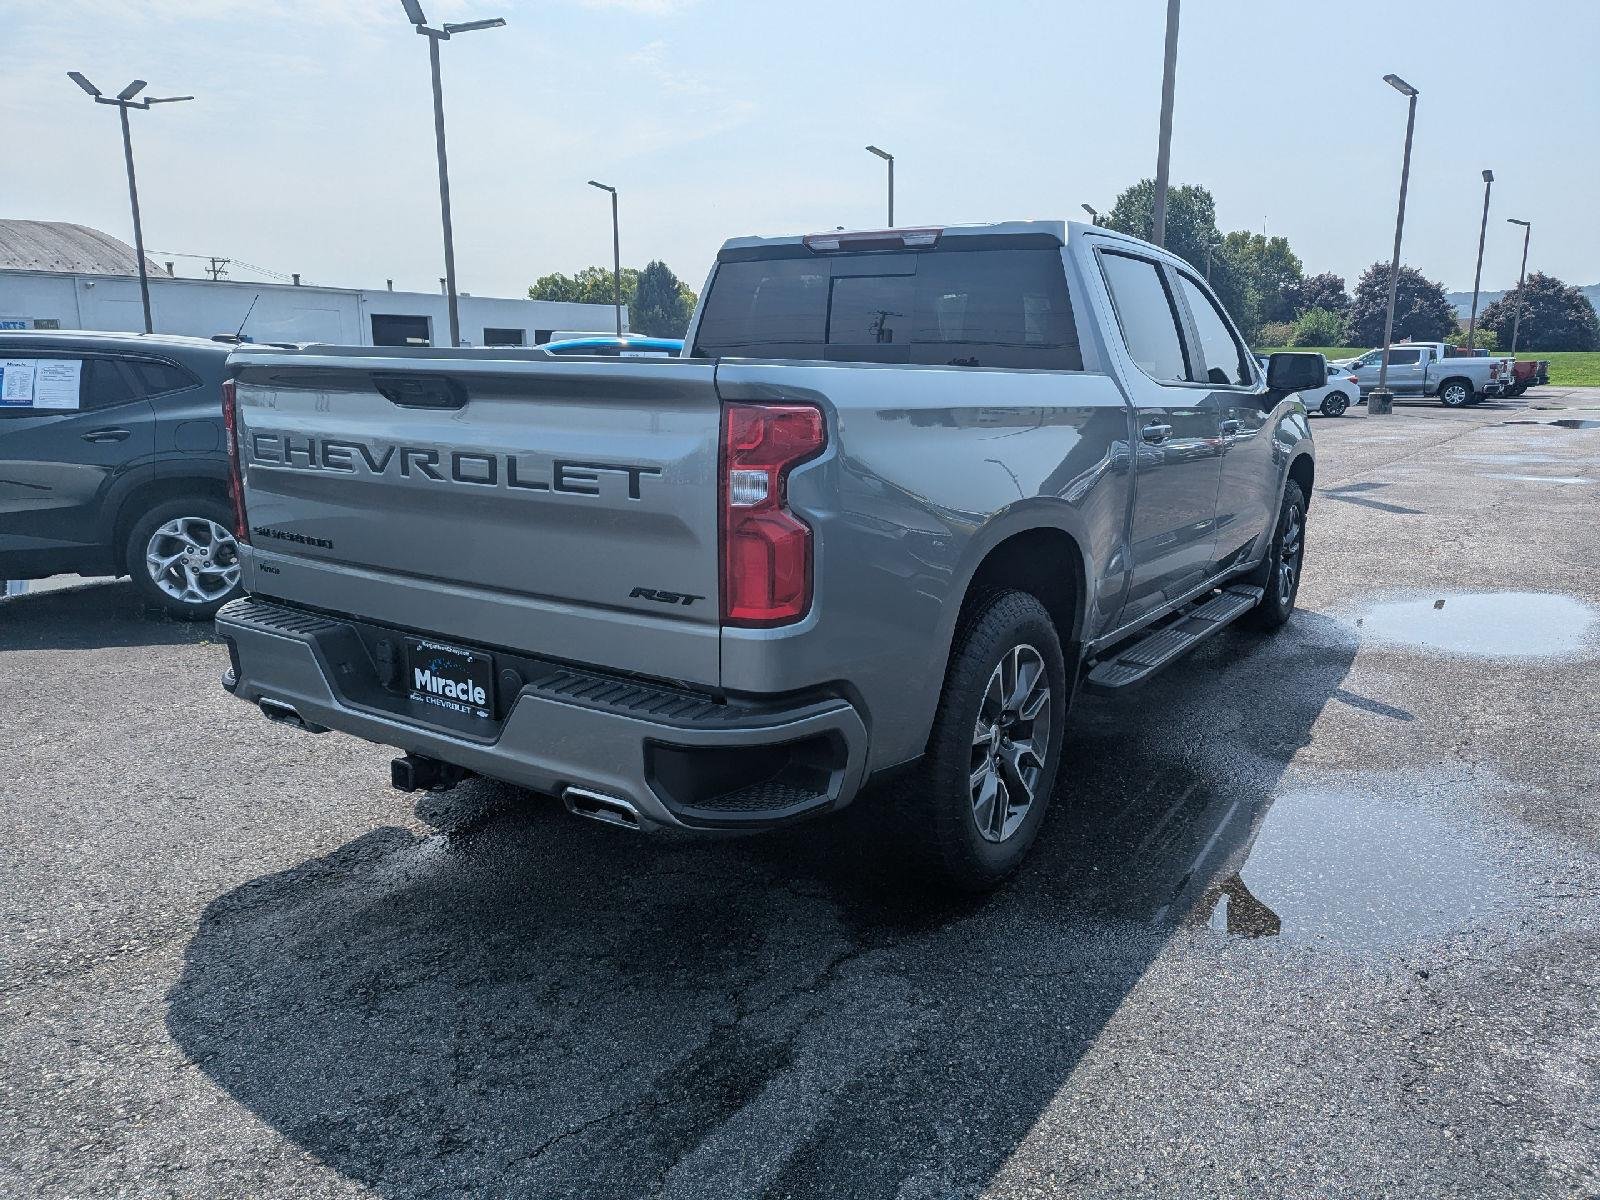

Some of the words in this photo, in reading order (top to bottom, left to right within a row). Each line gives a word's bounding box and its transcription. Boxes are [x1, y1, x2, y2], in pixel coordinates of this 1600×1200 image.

[252, 432, 663, 500] CHEVROLET
[628, 586, 706, 606] RST
[414, 667, 486, 705] Miracle
[425, 696, 472, 714] CHEVROLET
